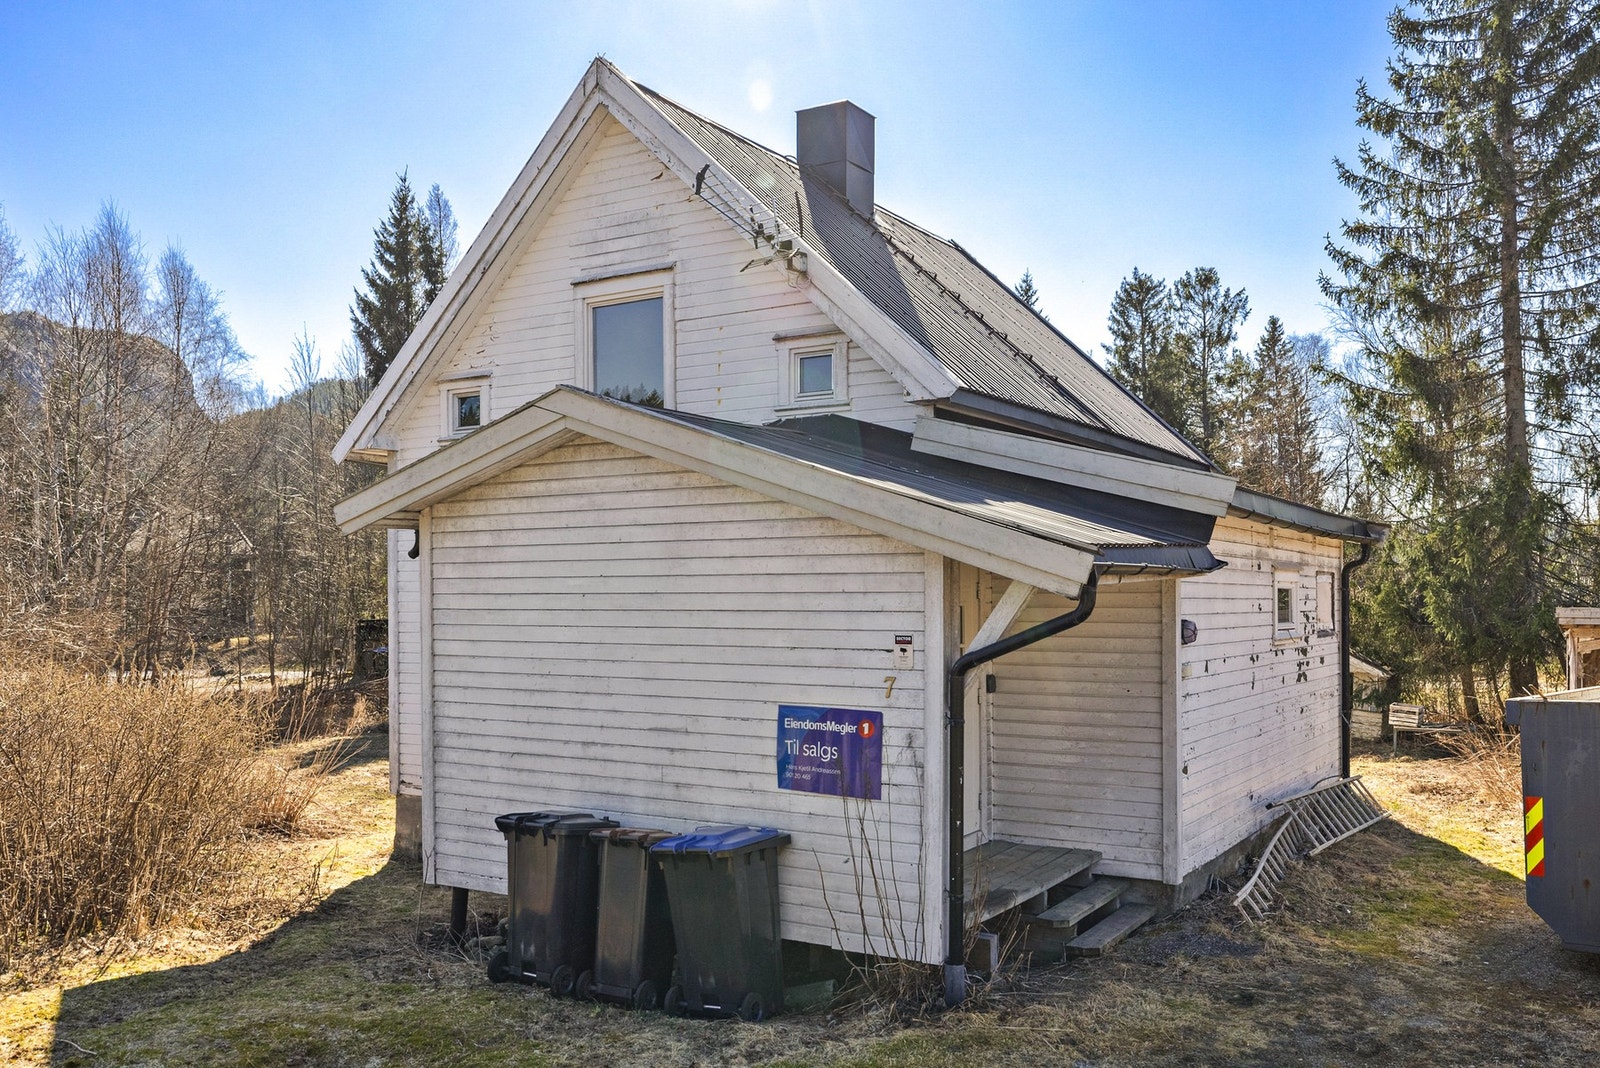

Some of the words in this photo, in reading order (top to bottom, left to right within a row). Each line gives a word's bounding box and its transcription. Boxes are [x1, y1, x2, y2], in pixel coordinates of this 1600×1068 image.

[884, 677, 896, 698] 7
[784, 718, 857, 735] EiendomsMegler
[862, 722, 869, 735] 1
[784, 739, 799, 755] Til
[802, 741, 838, 762] salgs
